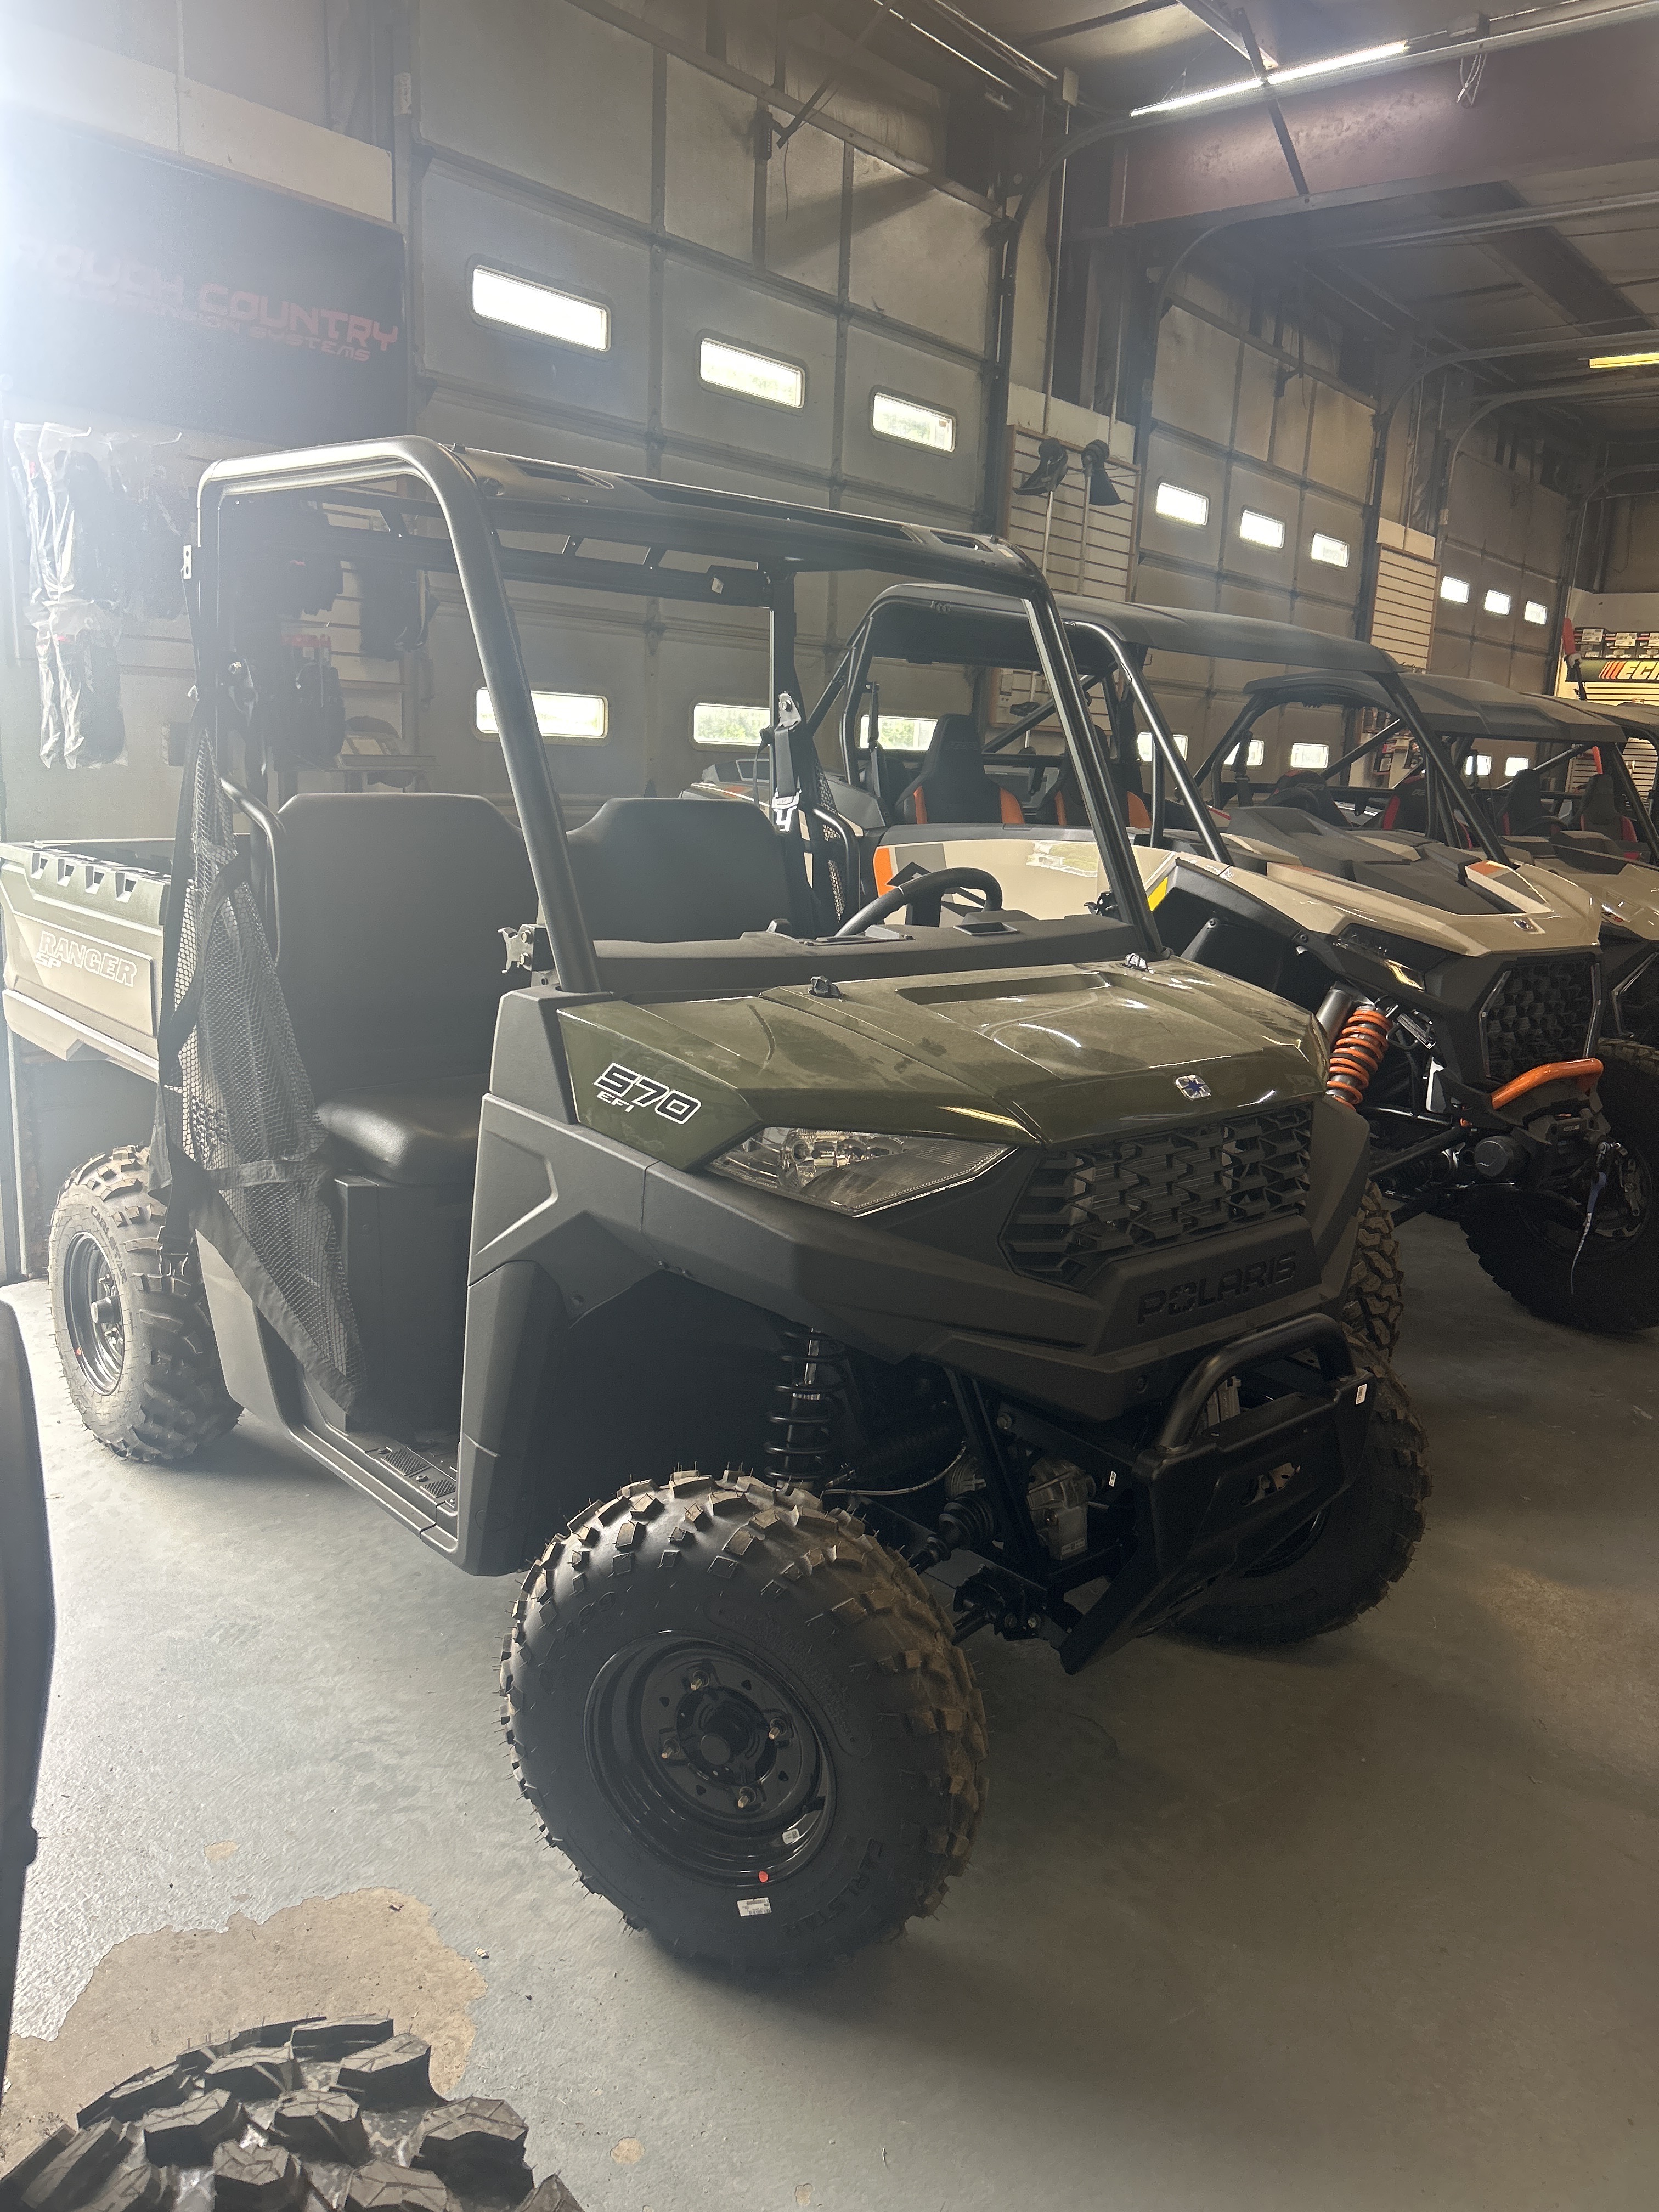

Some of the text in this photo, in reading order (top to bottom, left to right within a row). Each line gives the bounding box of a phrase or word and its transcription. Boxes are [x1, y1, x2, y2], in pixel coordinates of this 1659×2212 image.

[199, 282, 399, 351] COUNTRY
[249, 326, 370, 362] SYSTEMS
[35, 953, 61, 968] SP
[40, 931, 137, 987] RANGER
[594, 1062, 701, 1124] 570
[597, 1091, 634, 1112] EFI
[1138, 1251, 1296, 1325] POLARIS
